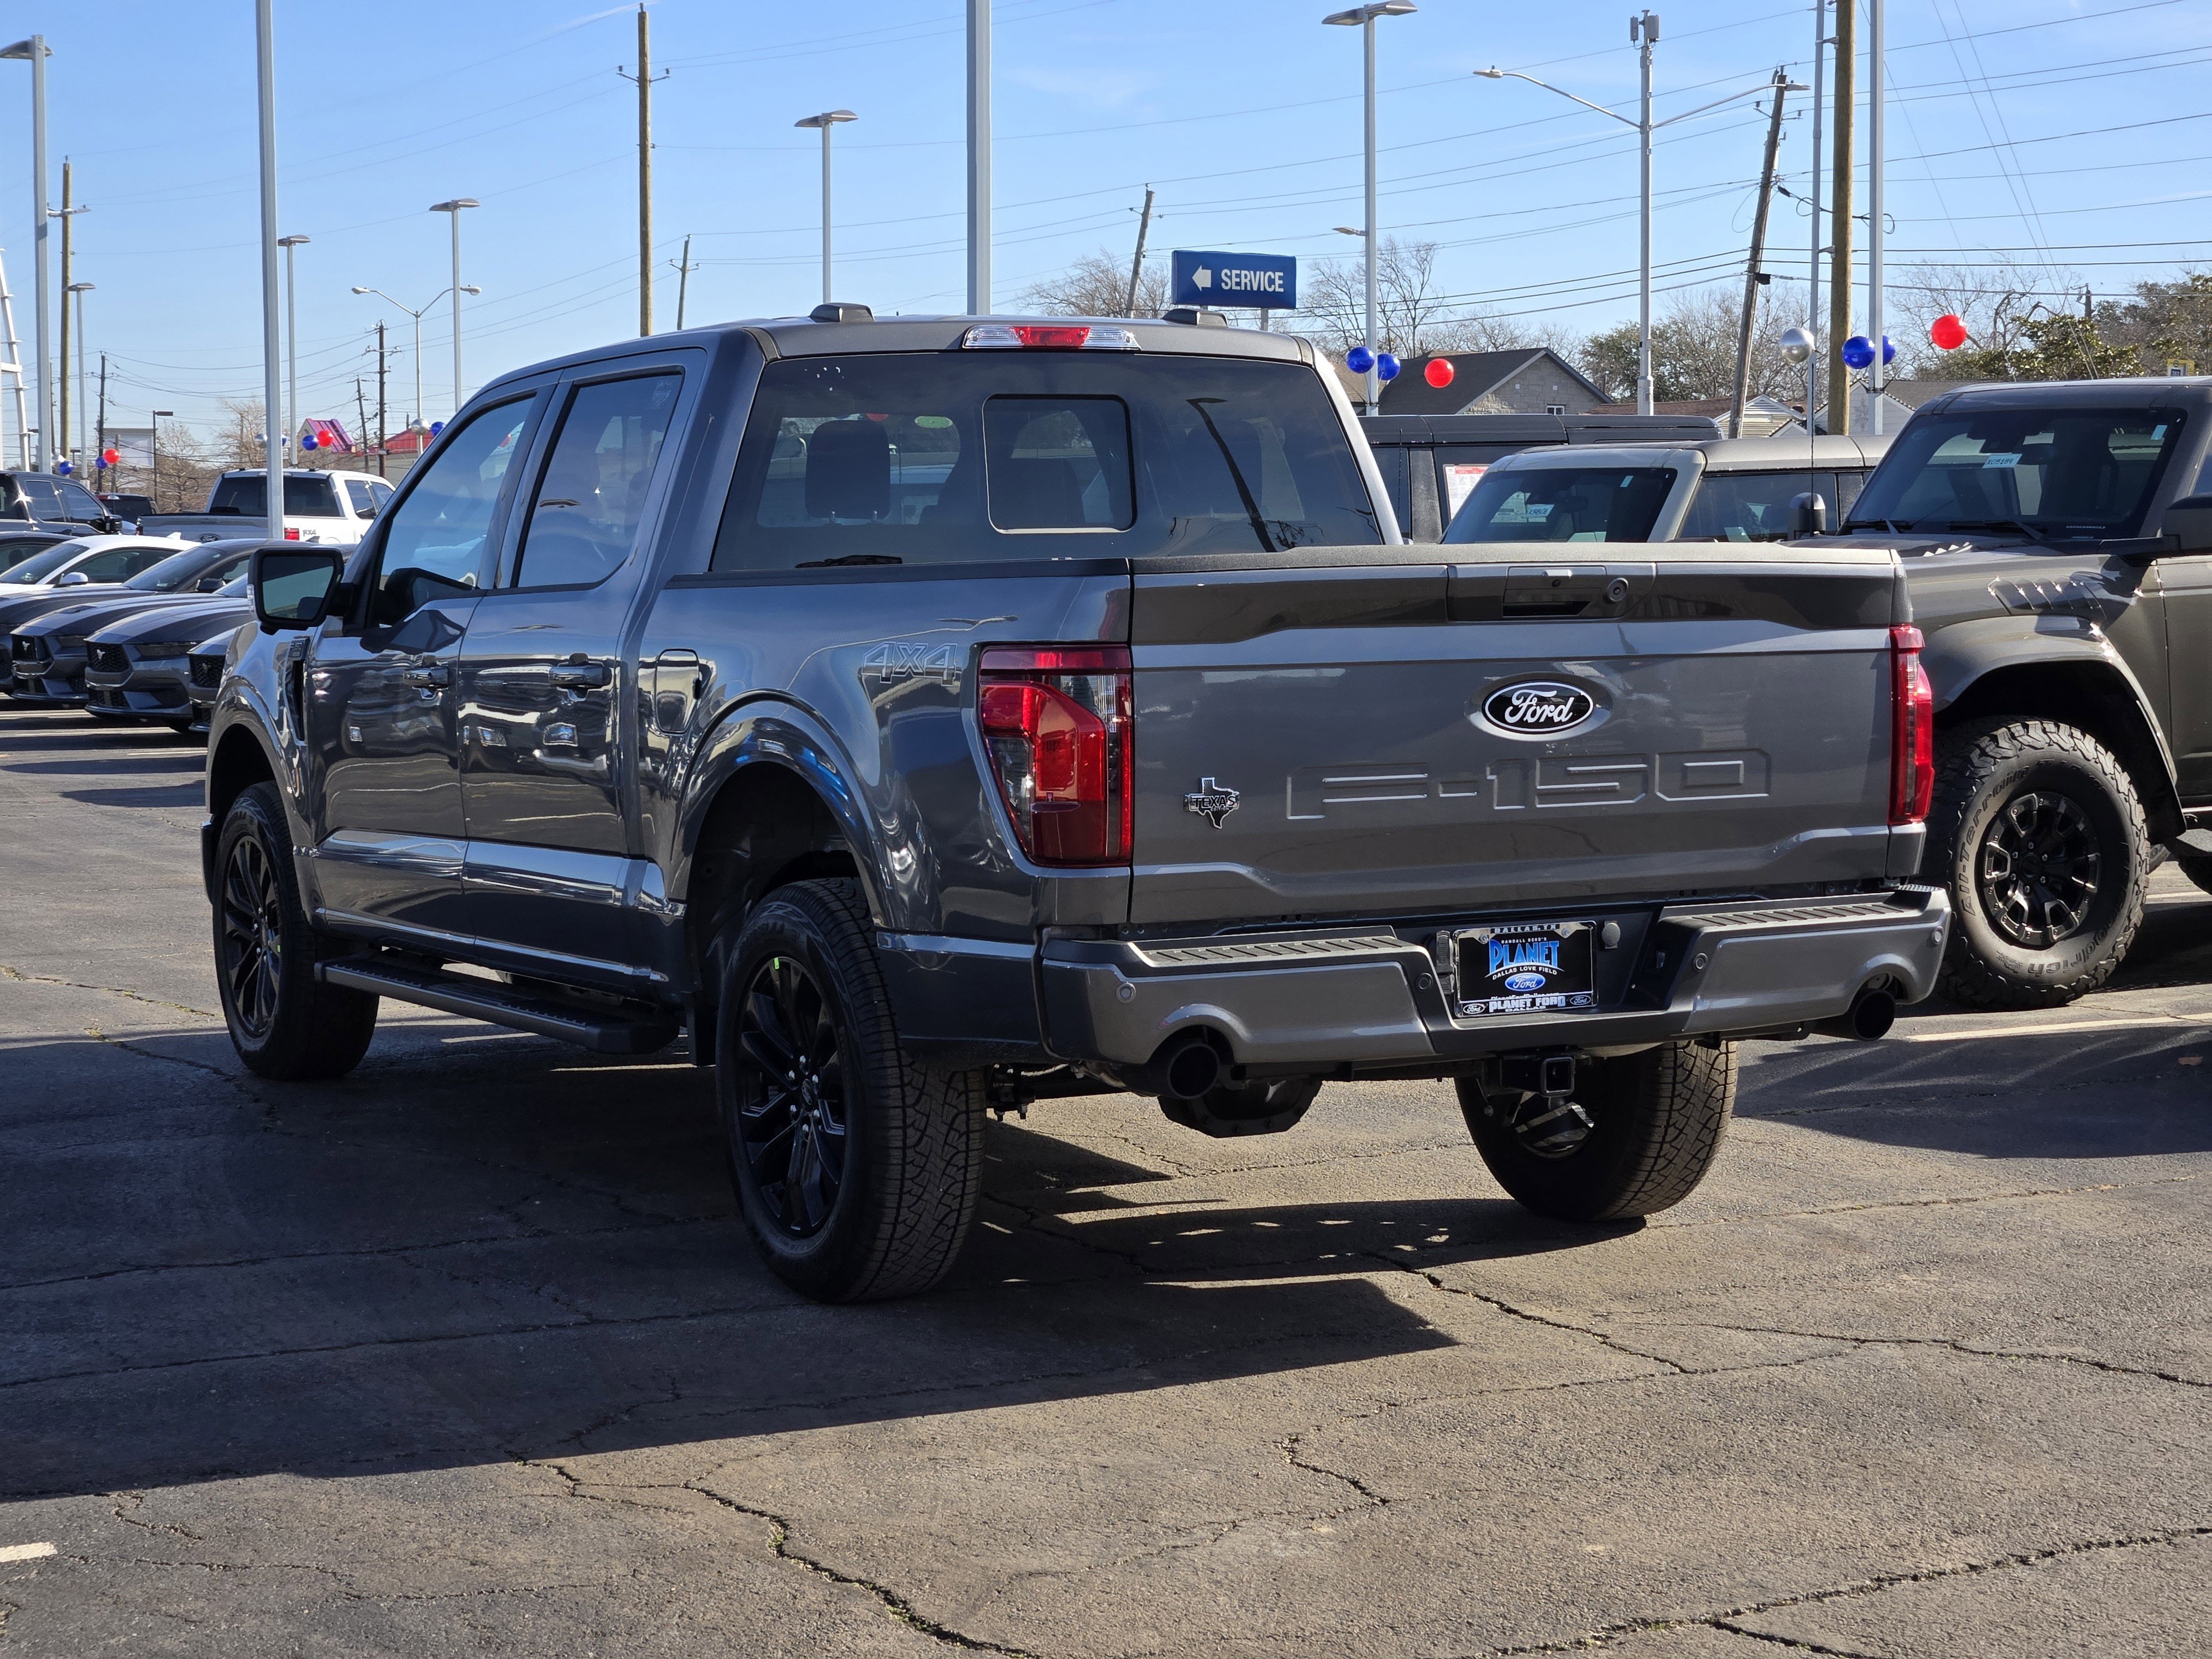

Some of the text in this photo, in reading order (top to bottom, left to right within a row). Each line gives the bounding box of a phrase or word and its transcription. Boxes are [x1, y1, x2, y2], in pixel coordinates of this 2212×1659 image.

[1220, 268, 1284, 293] SERVICE
[1504, 689, 1575, 723] Ford
[1286, 747, 1770, 820] F-150
[1191, 795, 1237, 808] TEXAS
[1489, 939, 1559, 974] PLANET
[1492, 967, 1517, 980] DALLAS
[1538, 966, 1557, 975] FIELD
[1512, 975, 1537, 989] Ford
[1489, 996, 1566, 1013] PLANET FORD
